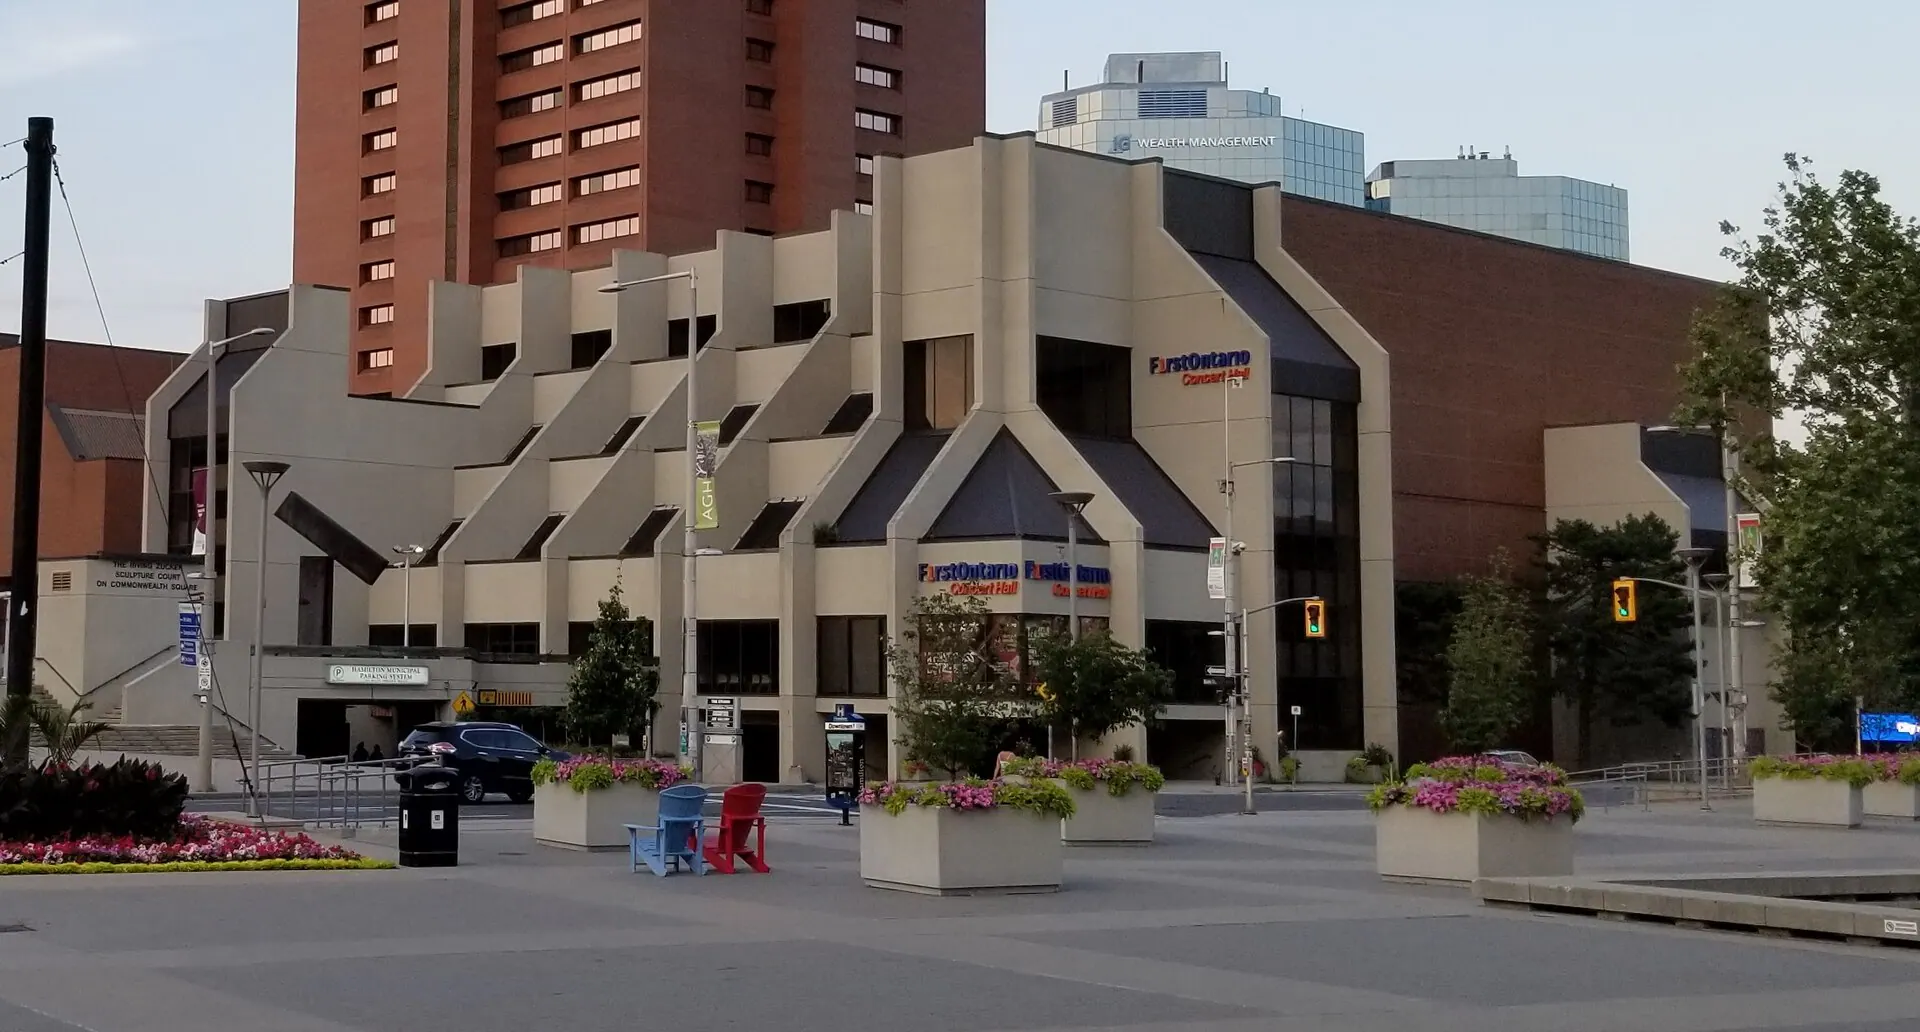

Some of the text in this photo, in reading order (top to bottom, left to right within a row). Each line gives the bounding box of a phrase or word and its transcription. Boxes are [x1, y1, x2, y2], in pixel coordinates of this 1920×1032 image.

[1137, 137, 1186, 149] WEALTH
[1189, 135, 1276, 148] MANAGEMENT
[1182, 370, 1227, 386] Concert
[702, 480, 713, 520] AGH
[115, 571, 181, 581] SCULPTURE COURT
[110, 580, 168, 590] COMMONWEALTH
[171, 583, 198, 591] SQUARE
[996, 581, 1019, 595] Hall
[351, 666, 385, 674] HAMILTON
